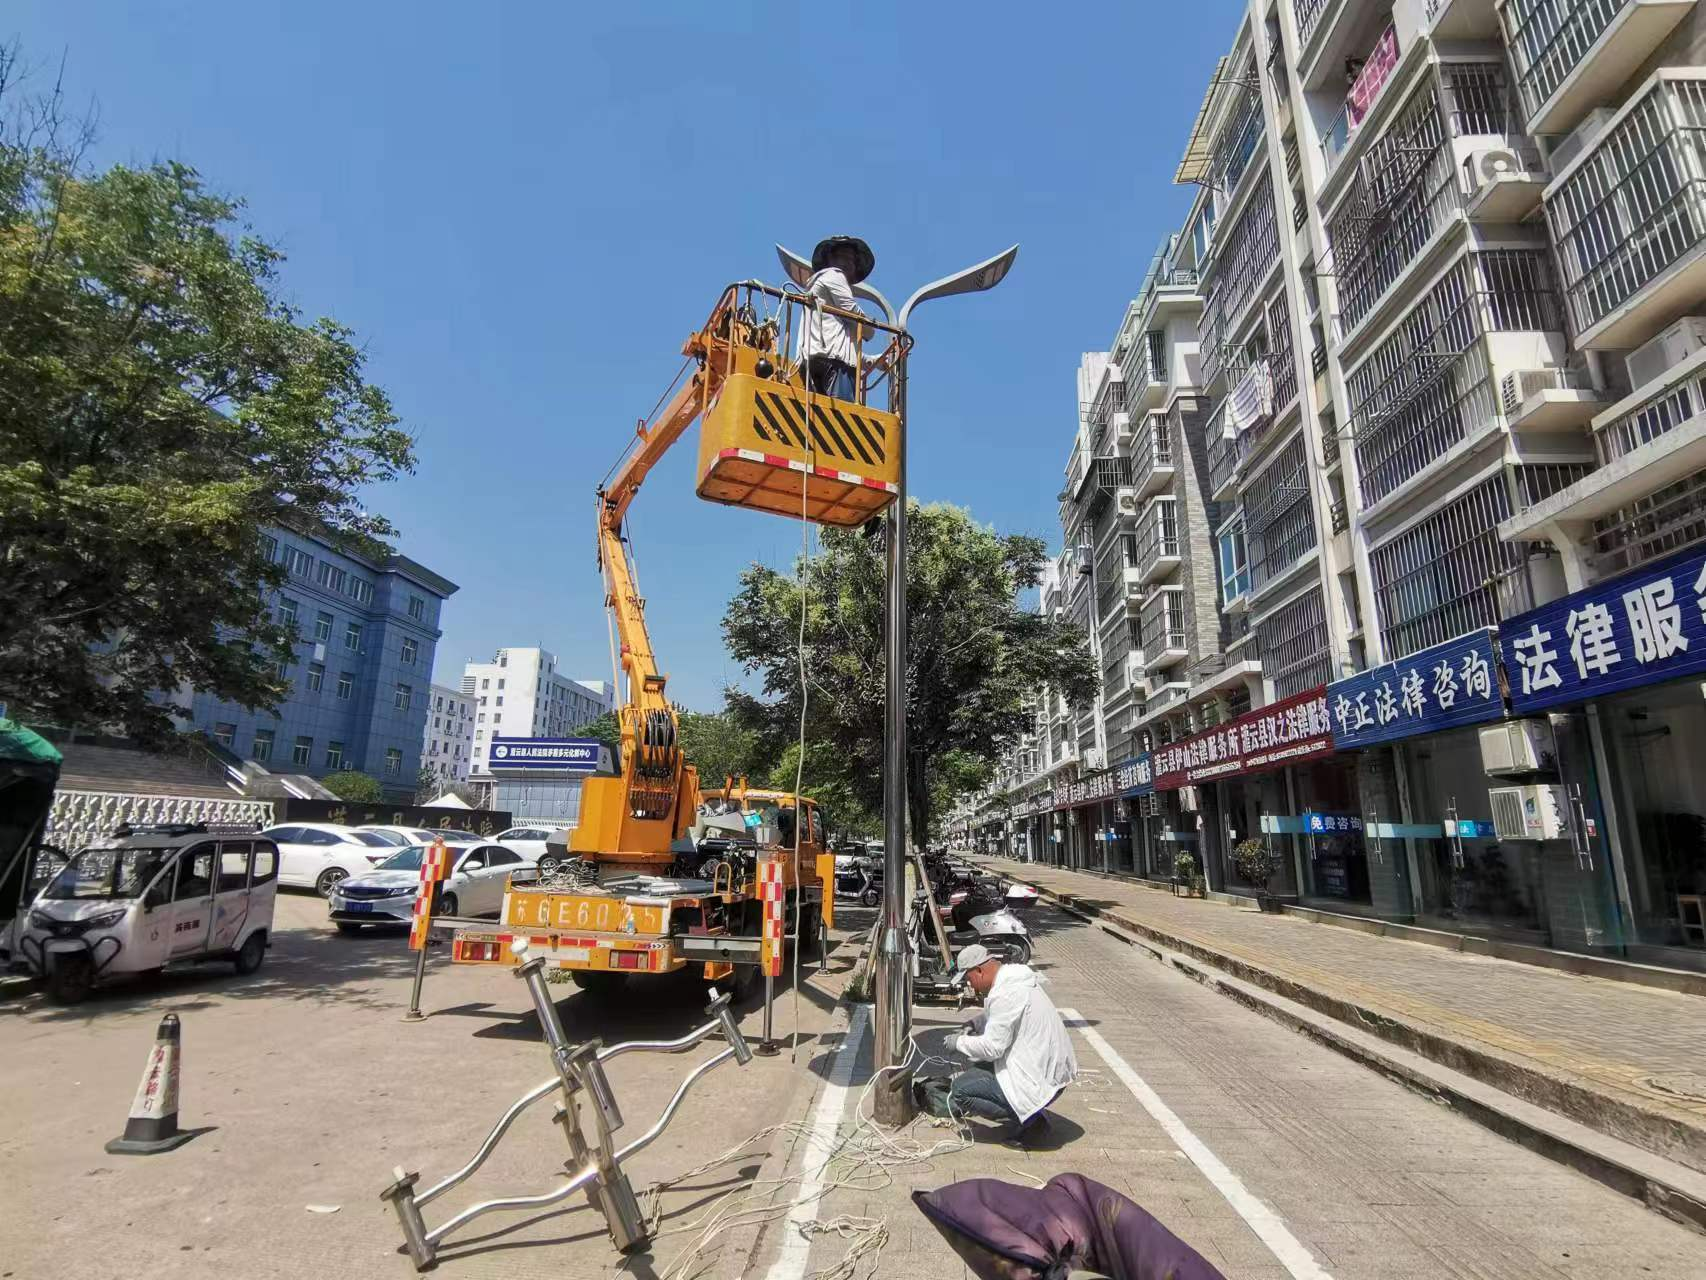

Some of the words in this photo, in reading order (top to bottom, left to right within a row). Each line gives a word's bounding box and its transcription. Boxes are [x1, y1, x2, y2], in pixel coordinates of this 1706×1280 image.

[1334, 649, 1490, 735] 中正法律咨询
[1312, 815, 1362, 831] 免费咨询
